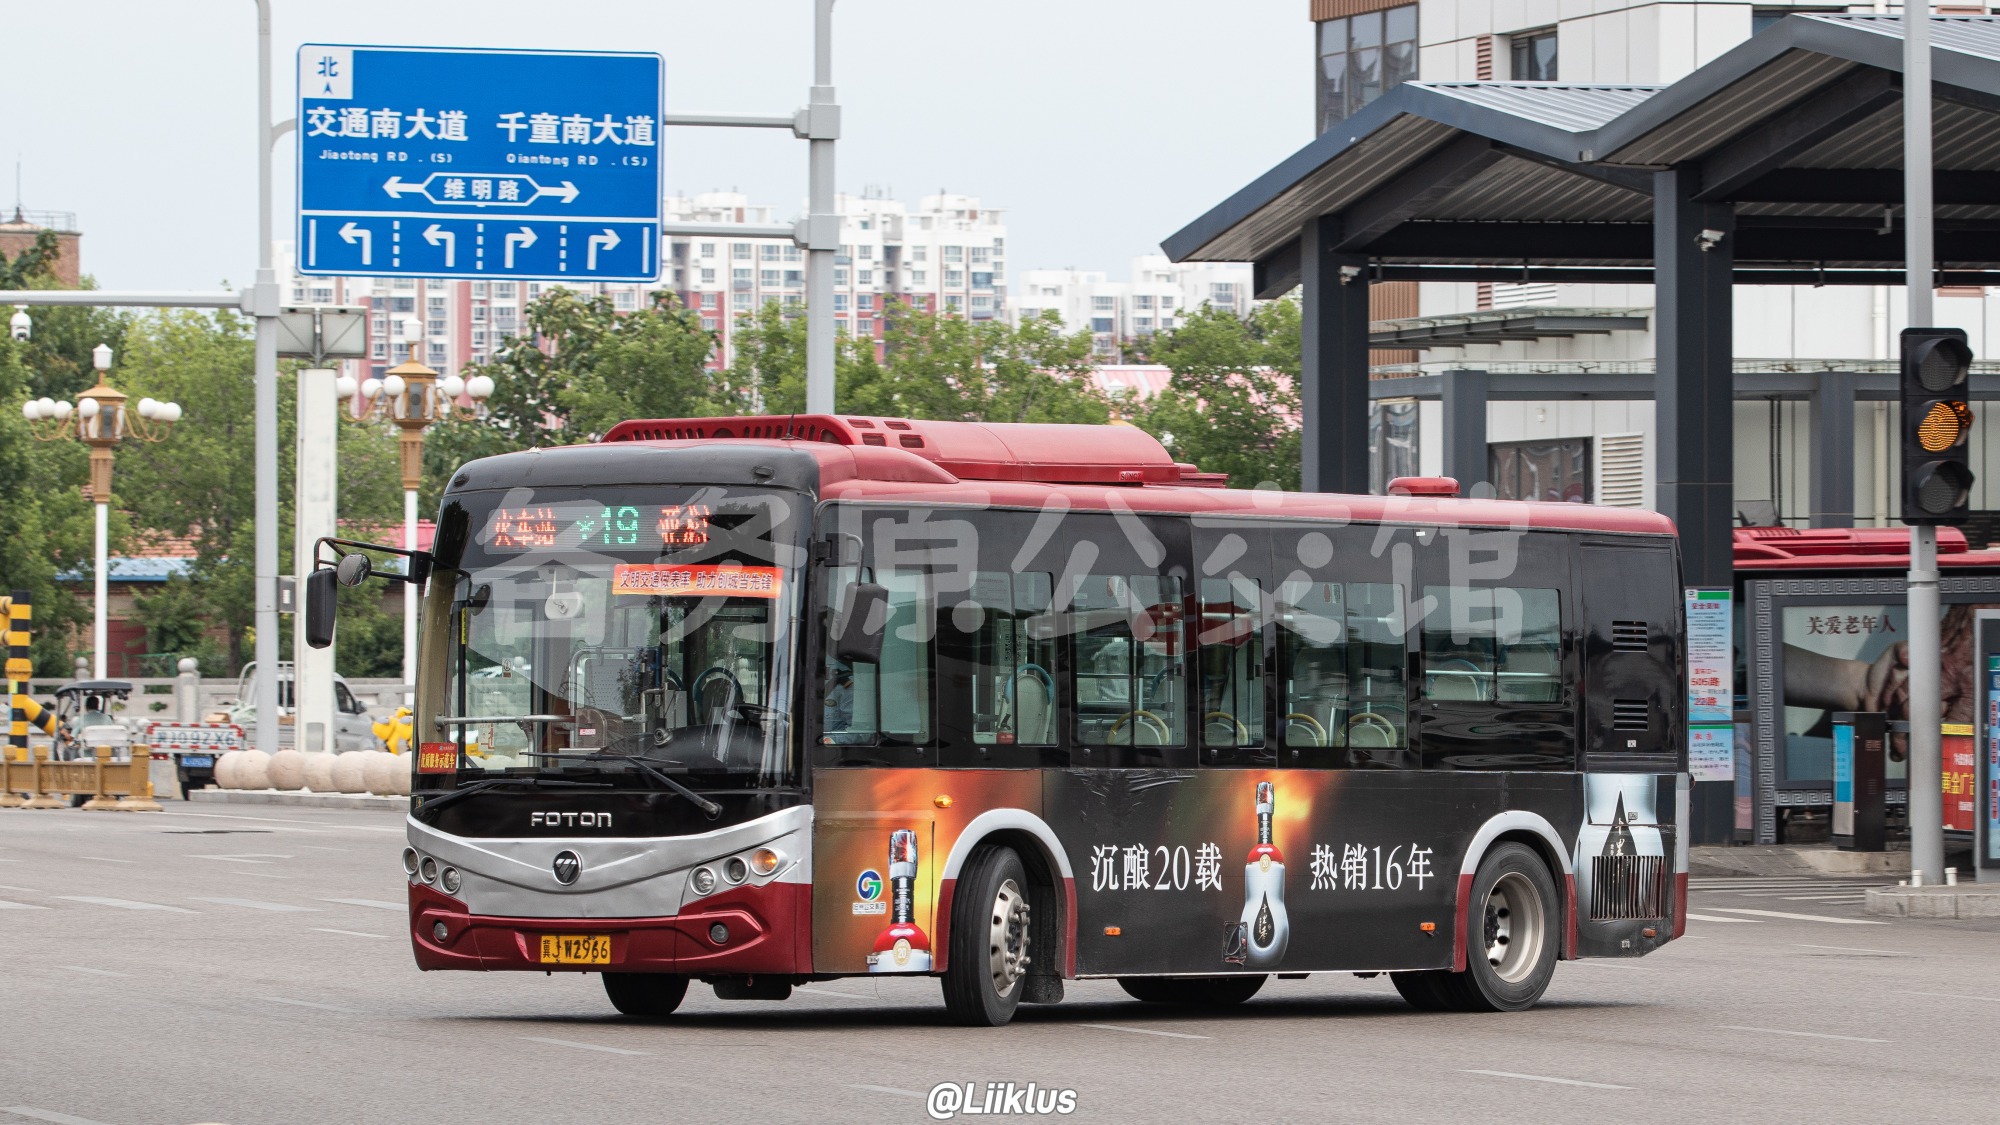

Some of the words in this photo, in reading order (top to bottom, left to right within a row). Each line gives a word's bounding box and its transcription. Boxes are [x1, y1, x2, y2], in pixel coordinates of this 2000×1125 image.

[318, 56, 338, 77] 北
[306, 106, 469, 142] 交通南大道
[496, 112, 656, 146] 千童南大道
[319, 150, 378, 163] Jiaotong
[506, 153, 569, 167] Qiantong
[444, 178, 520, 201] 维明路
[620, 571, 692, 588] 文明交通做表率
[695, 572, 773, 590] 助力创城当先锋
[1806, 614, 1896, 635] 关爱老年人
[531, 811, 612, 827] FOTON
[1090, 842, 1223, 891] 沉酿20载
[1310, 842, 1434, 891] 热销16年
